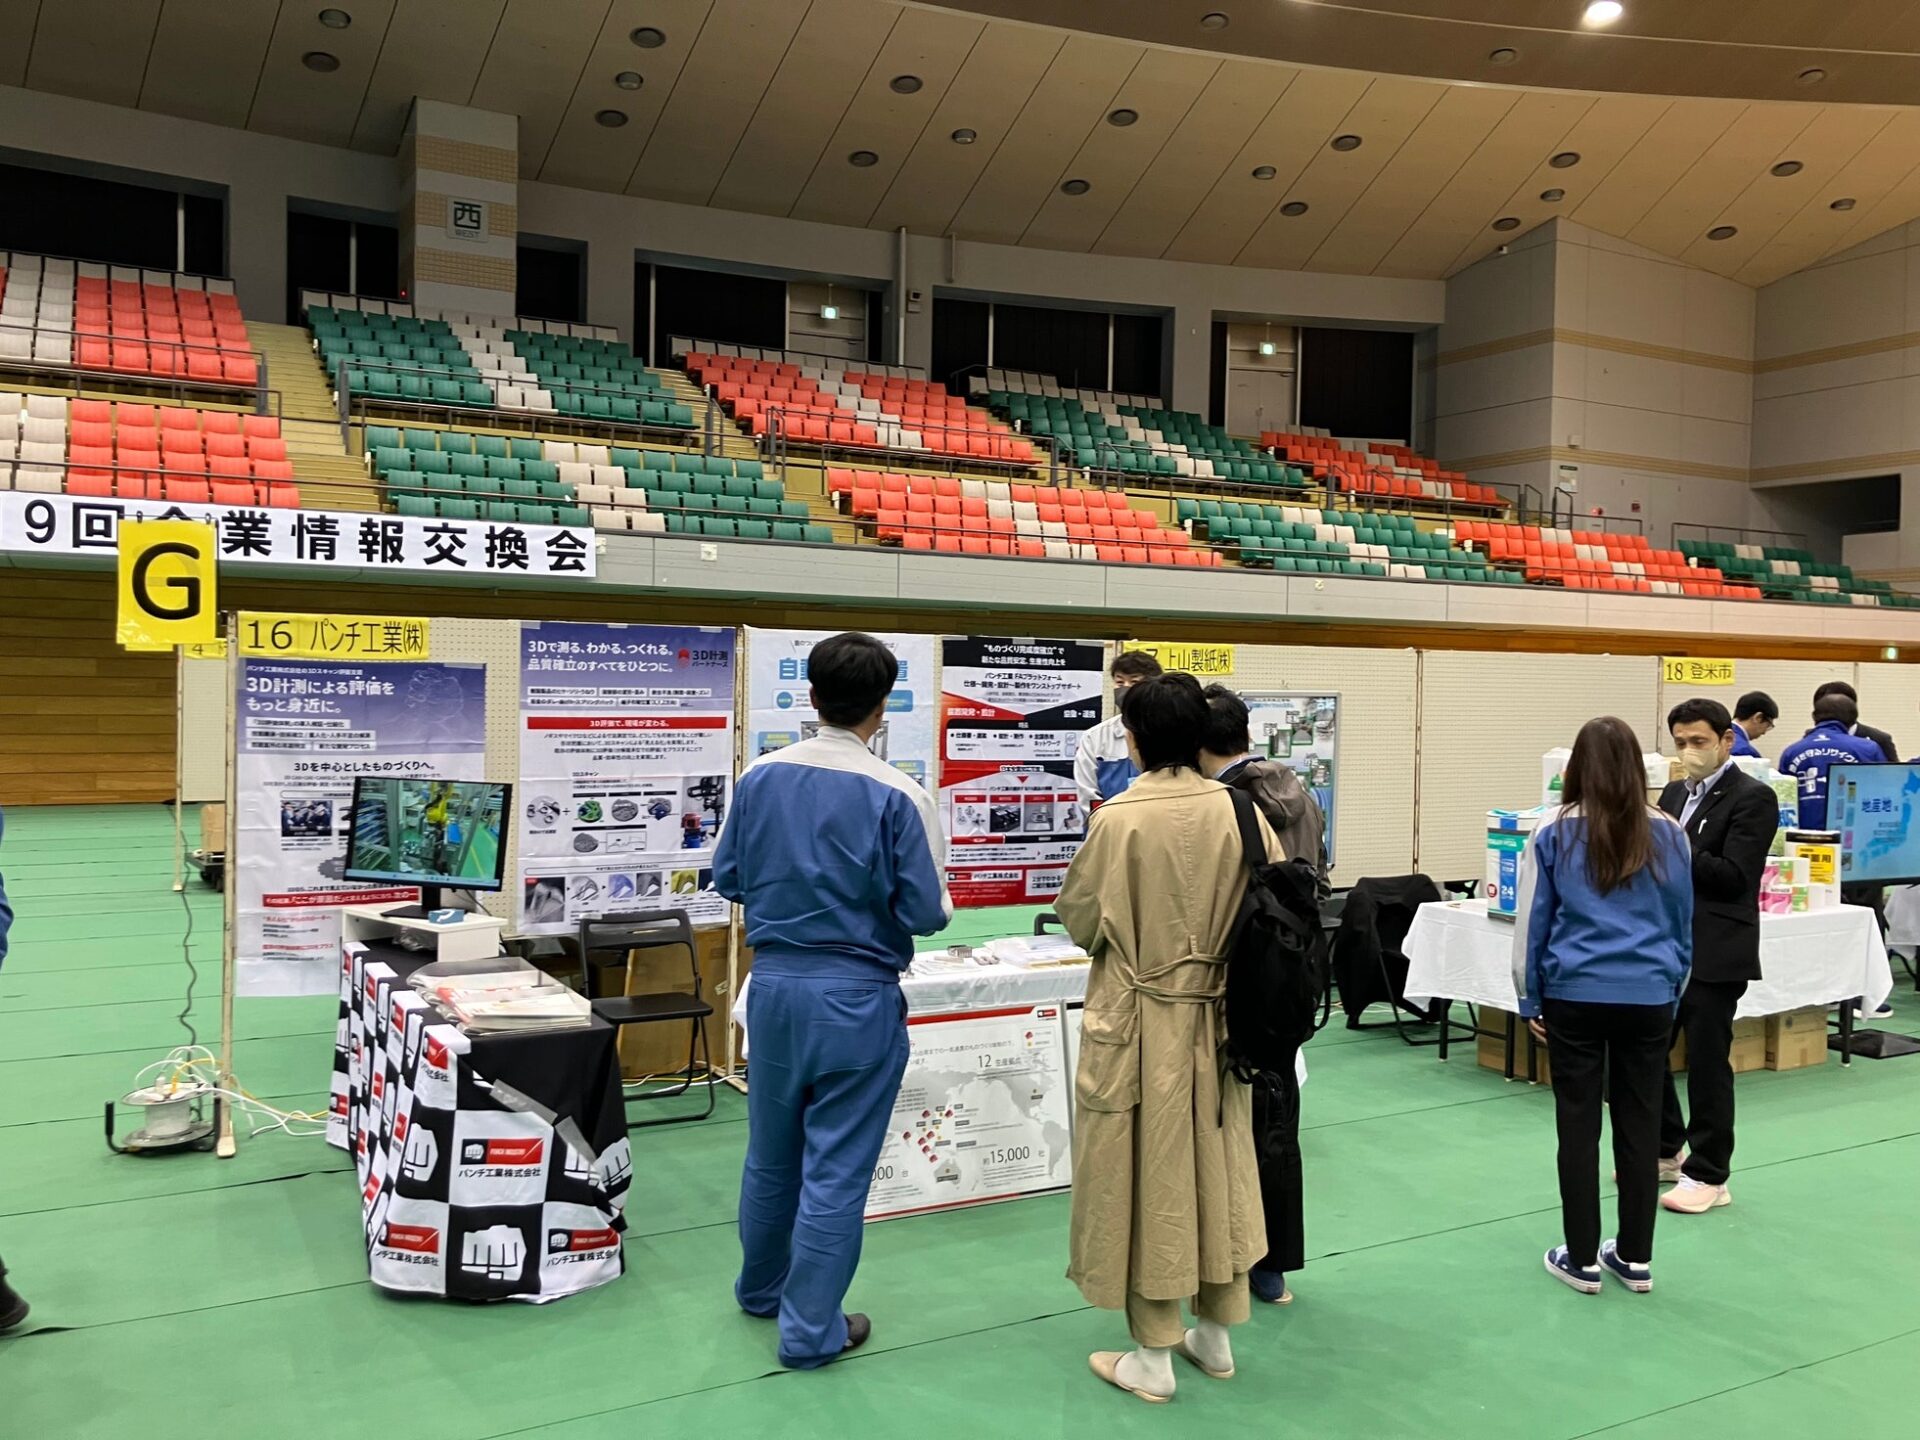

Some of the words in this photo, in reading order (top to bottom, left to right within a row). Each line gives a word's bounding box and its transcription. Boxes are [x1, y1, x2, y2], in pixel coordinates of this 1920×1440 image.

[453, 201, 482, 230] 西
[132, 542, 200, 620] G
[247, 620, 293, 650] 16
[528, 640, 673, 656] 3Dで測る、わかる、つくれる。
[692, 650, 728, 661] 3D計測
[527, 658, 673, 673] 品質確立のすべてをひとつに。
[1666, 662, 1683, 681] 18
[1690, 662, 1732, 680] 登米市
[246, 677, 395, 696] 3D計測による評価を
[246, 697, 342, 714] もっと身近に。
[294, 761, 435, 773] 3Dを中心としたものづくりへ。
[978, 1054, 992, 1068] 12
[458, 1167, 541, 1178] パンチ工業株式会社
